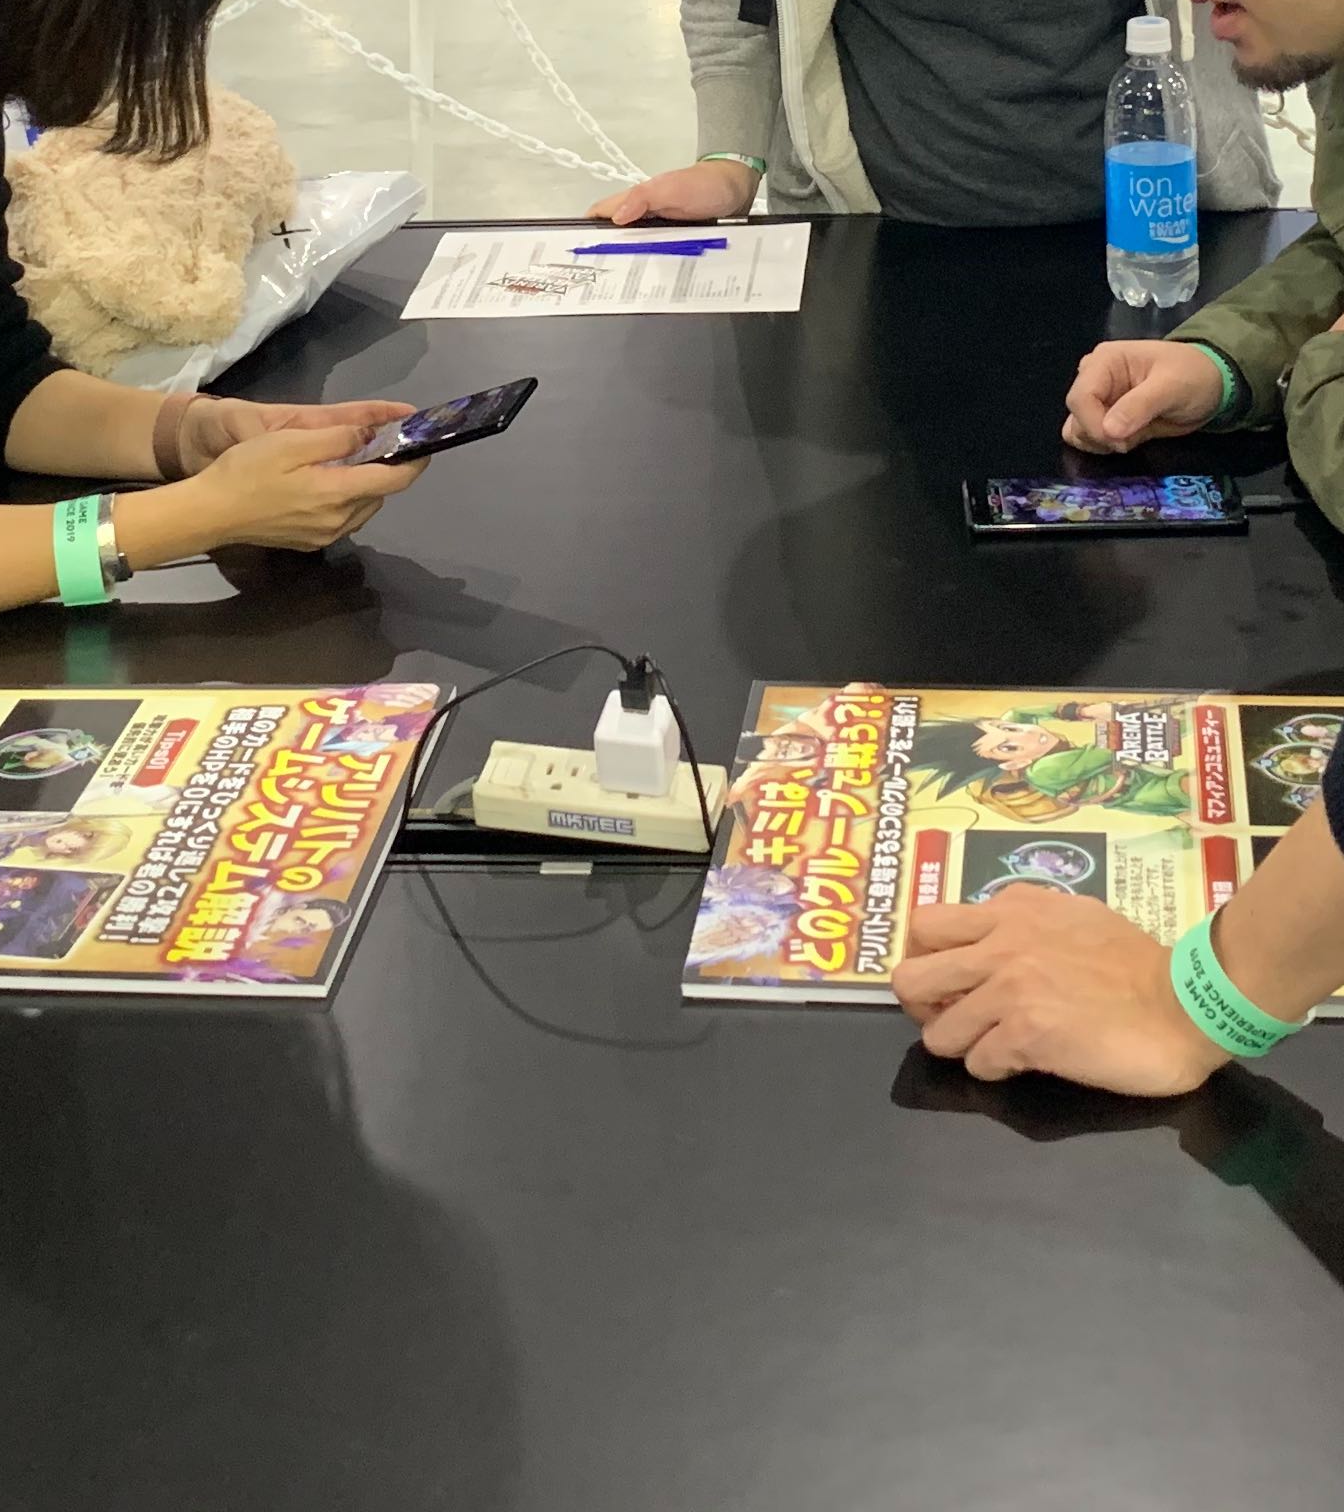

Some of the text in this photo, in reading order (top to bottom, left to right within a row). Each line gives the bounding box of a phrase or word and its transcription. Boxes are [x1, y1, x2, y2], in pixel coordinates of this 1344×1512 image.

[1128, 192, 1195, 218] wate
[1129, 171, 1173, 197] ion
[66, 519, 75, 542] 2019
[145, 729, 187, 771] Tips01
[1115, 711, 1142, 762] ARENA
[1143, 711, 1170, 763] BATTLE
[166, 697, 359, 963] ゲームシステム解説
[276, 753, 391, 891] アリバトの
[746, 768, 814, 866] キミは、
[1189, 947, 1205, 979] 2019
[1184, 977, 1217, 1020] GAME
